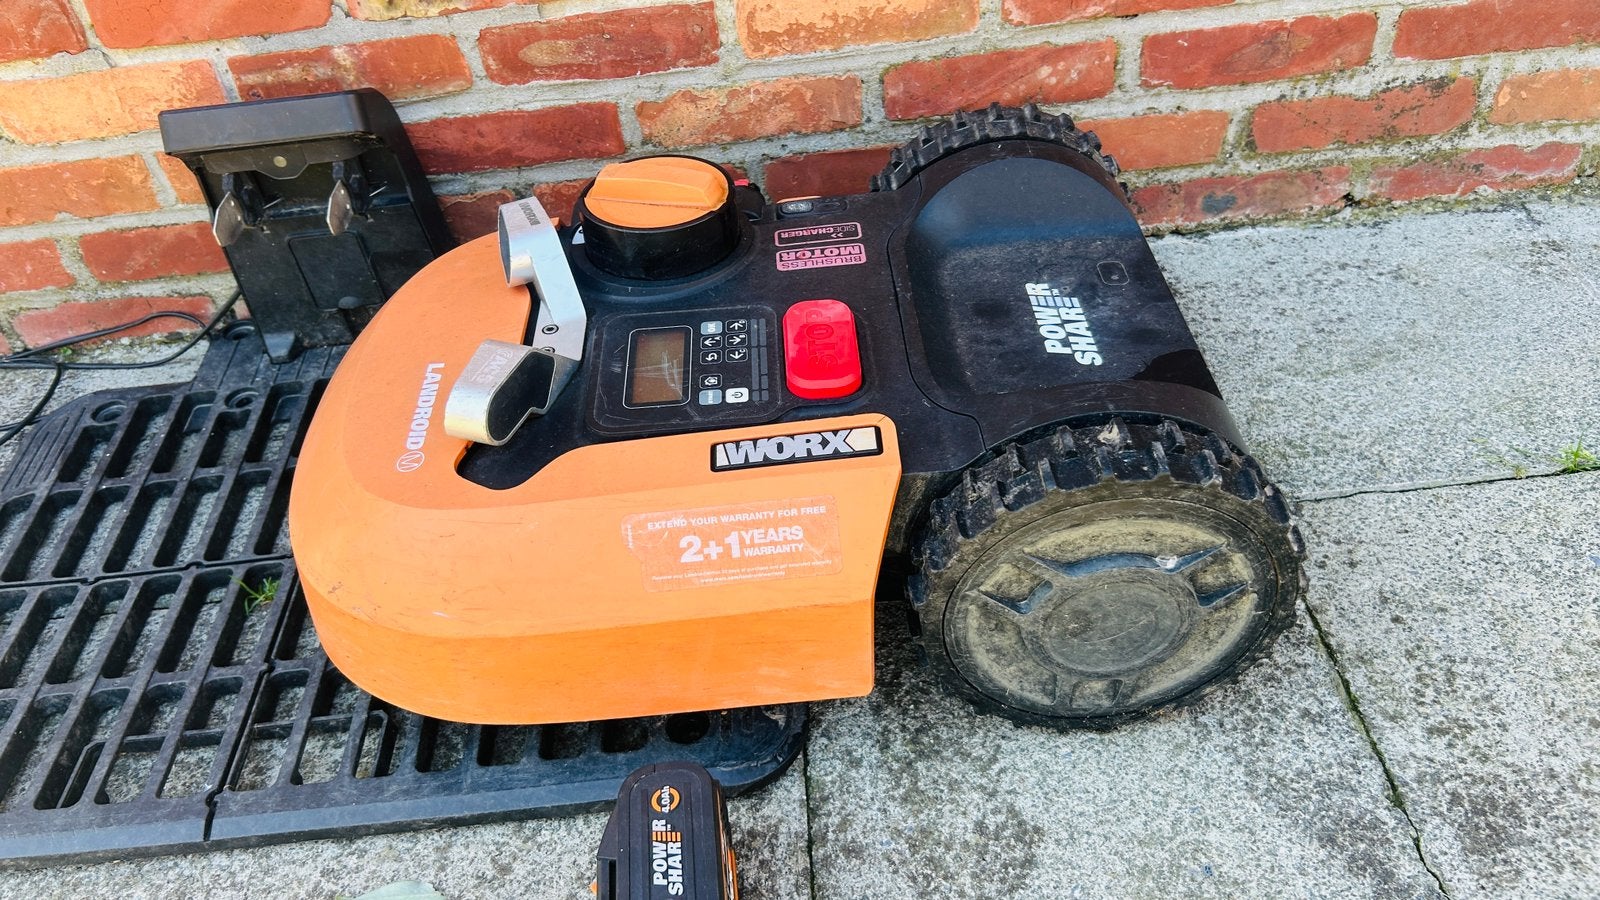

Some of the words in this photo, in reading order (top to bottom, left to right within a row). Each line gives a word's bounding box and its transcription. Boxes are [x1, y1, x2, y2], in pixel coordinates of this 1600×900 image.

[781, 245, 861, 261] MOTOR
[781, 255, 862, 269] BRUSHLESS
[1025, 282, 1073, 354] POWER
[1055, 296, 1103, 366] SHARE
[805, 307, 839, 369] STOP
[406, 362, 446, 450] LANDROID
[724, 429, 855, 465] WORX
[647, 517, 688, 530] EXTEND
[690, 515, 719, 526] YOUR
[719, 511, 775, 524] WARRANTY
[777, 508, 798, 518] FOR
[800, 505, 827, 516] FREE
[678, 530, 741, 564] 2+1
[740, 525, 804, 545] YEARS
[743, 542, 804, 558] WARRANTY
[661, 785, 671, 814] 4.0Ah
[651, 819, 668, 886] POWER
[666, 831, 684, 896] SHARE
